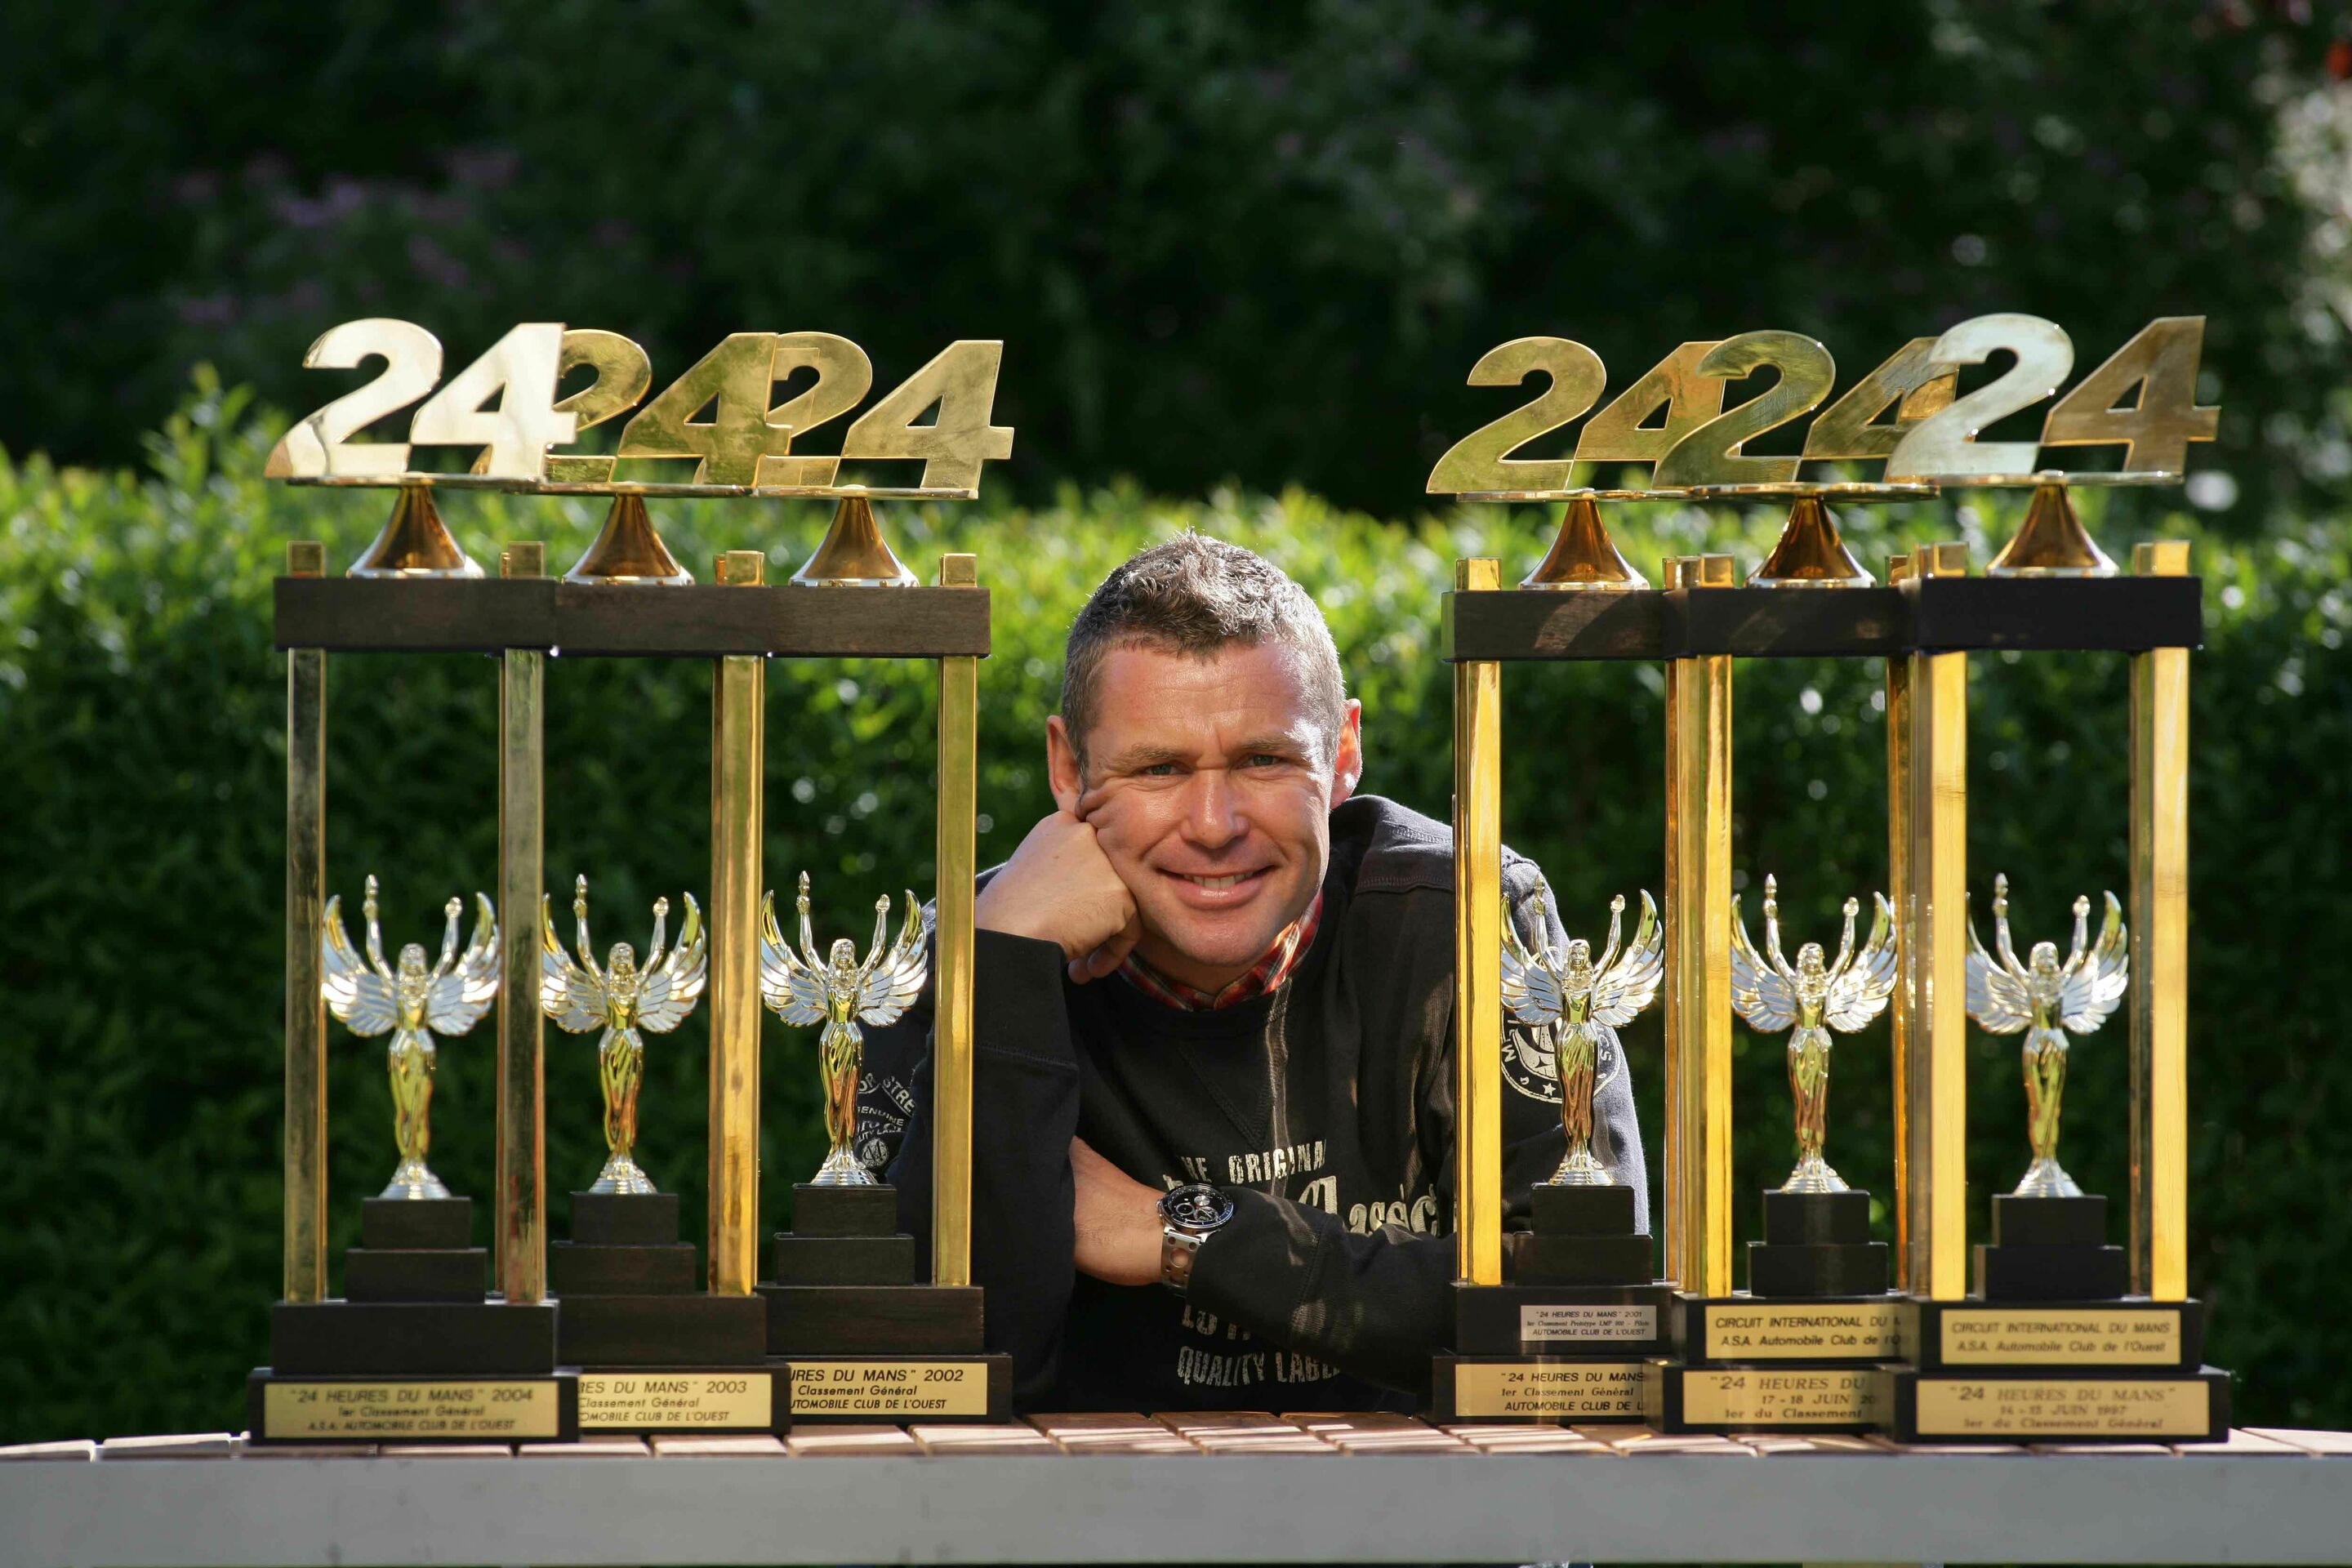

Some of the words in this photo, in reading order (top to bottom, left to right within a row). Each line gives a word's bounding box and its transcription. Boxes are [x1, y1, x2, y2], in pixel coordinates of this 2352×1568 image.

[265, 318, 577, 478] 24
[1884, 313, 2221, 476] 24
[1651, 330, 1958, 485] 24
[1426, 336, 1741, 494] 24
[1228, 1139, 1326, 1184] ORIGINA
[1716, 1316, 1763, 1329] CIRCUIT
[1770, 1316, 1862, 1329] INTERNATIONAL
[1870, 1316, 1887, 1329] DU
[1953, 1322, 2000, 1334] CIRCUIT
[2007, 1322, 2100, 1334] INTERNATIONAL
[2109, 1322, 2127, 1334] DU
[2133, 1322, 2171, 1334] MANS
[1759, 1334, 1824, 1346] Automobile
[1830, 1334, 1856, 1346] Club
[1864, 1334, 1878, 1346] de
[1997, 1342, 2063, 1352] Automobile
[2069, 1342, 2096, 1352] Club
[2103, 1342, 2118, 1352] de
[2125, 1342, 2166, 1352] l'Ouest
[1178, 1346, 1265, 1387] QUALITY
[833, 1370, 855, 1382] DU
[924, 1370, 964, 1382] 2002
[1531, 1373, 1579, 1382] HEURES
[1585, 1373, 1602, 1382] DU
[1609, 1373, 1644, 1382] MANS
[613, 1381, 635, 1394] DU
[706, 1381, 746, 1394] 2003
[798, 1384, 864, 1396] Classement
[870, 1384, 917, 1396] Général
[1759, 1378, 1829, 1390] HEURES
[1840, 1378, 1865, 1390] DU
[326, 1389, 390, 1403] HEURES
[397, 1389, 419, 1403] DU
[492, 1389, 533, 1403] 2004
[1524, 1388, 1584, 1397] Classement
[1592, 1388, 1633, 1397] Général
[1997, 1388, 2068, 1401] HEURES
[2078, 1388, 2102, 1401] DU
[578, 1397, 645, 1408] Classement
[651, 1397, 700, 1408] Général
[853, 1399, 880, 1409] CLUB
[885, 1399, 899, 1409] DE
[903, 1399, 947, 1409] L'OUEST
[1762, 1394, 1774, 1404] 17
[1790, 1394, 1803, 1404] 18
[1813, 1394, 1851, 1404] JUIN
[1860, 1394, 1876, 1404] 20
[360, 1405, 430, 1417] Classement
[435, 1405, 486, 1417] Général
[1505, 1401, 1575, 1410] AUTOMOBILE
[1581, 1401, 1610, 1410] CLUB
[1616, 1401, 1631, 1410] DE
[2051, 1405, 2088, 1415] JUIN
[635, 1411, 662, 1422] CLUB
[666, 1411, 680, 1422] DE
[686, 1411, 729, 1422] L'OUEST
[1755, 1408, 1772, 1419] du
[1783, 1408, 1862, 1419] Classement
[344, 1420, 414, 1431] AUTOMOBILE
[418, 1420, 447, 1431] CLUB
[451, 1420, 465, 1431] DE
[471, 1420, 515, 1431] L'OUEST
[2108, 1419, 2163, 1428] Général
